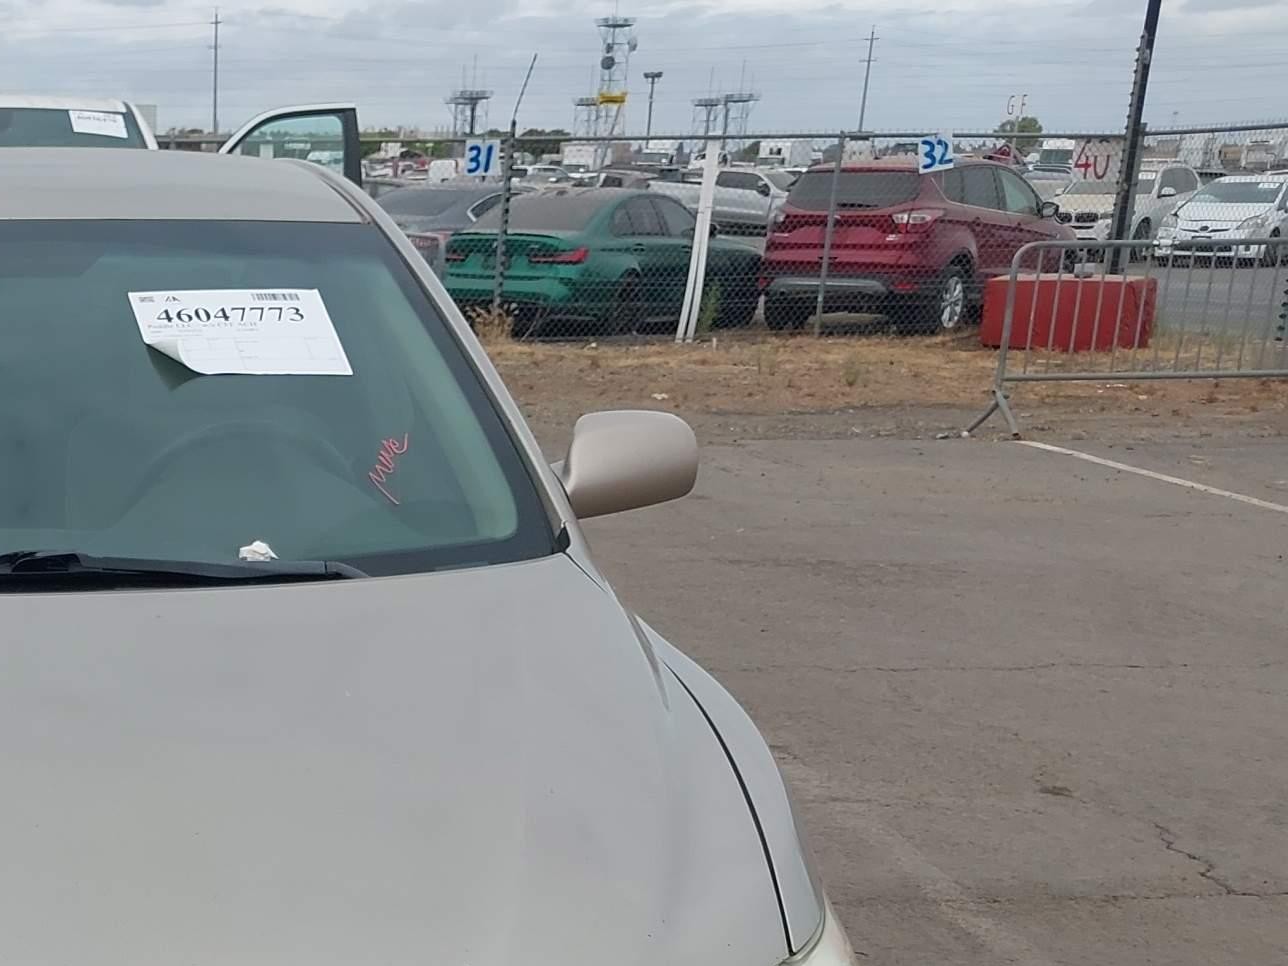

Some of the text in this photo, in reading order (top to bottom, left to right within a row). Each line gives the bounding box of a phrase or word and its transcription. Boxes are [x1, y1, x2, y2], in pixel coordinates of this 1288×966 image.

[467, 144, 493, 173] 31
[921, 139, 953, 169] 32
[156, 306, 305, 323] 46047773
